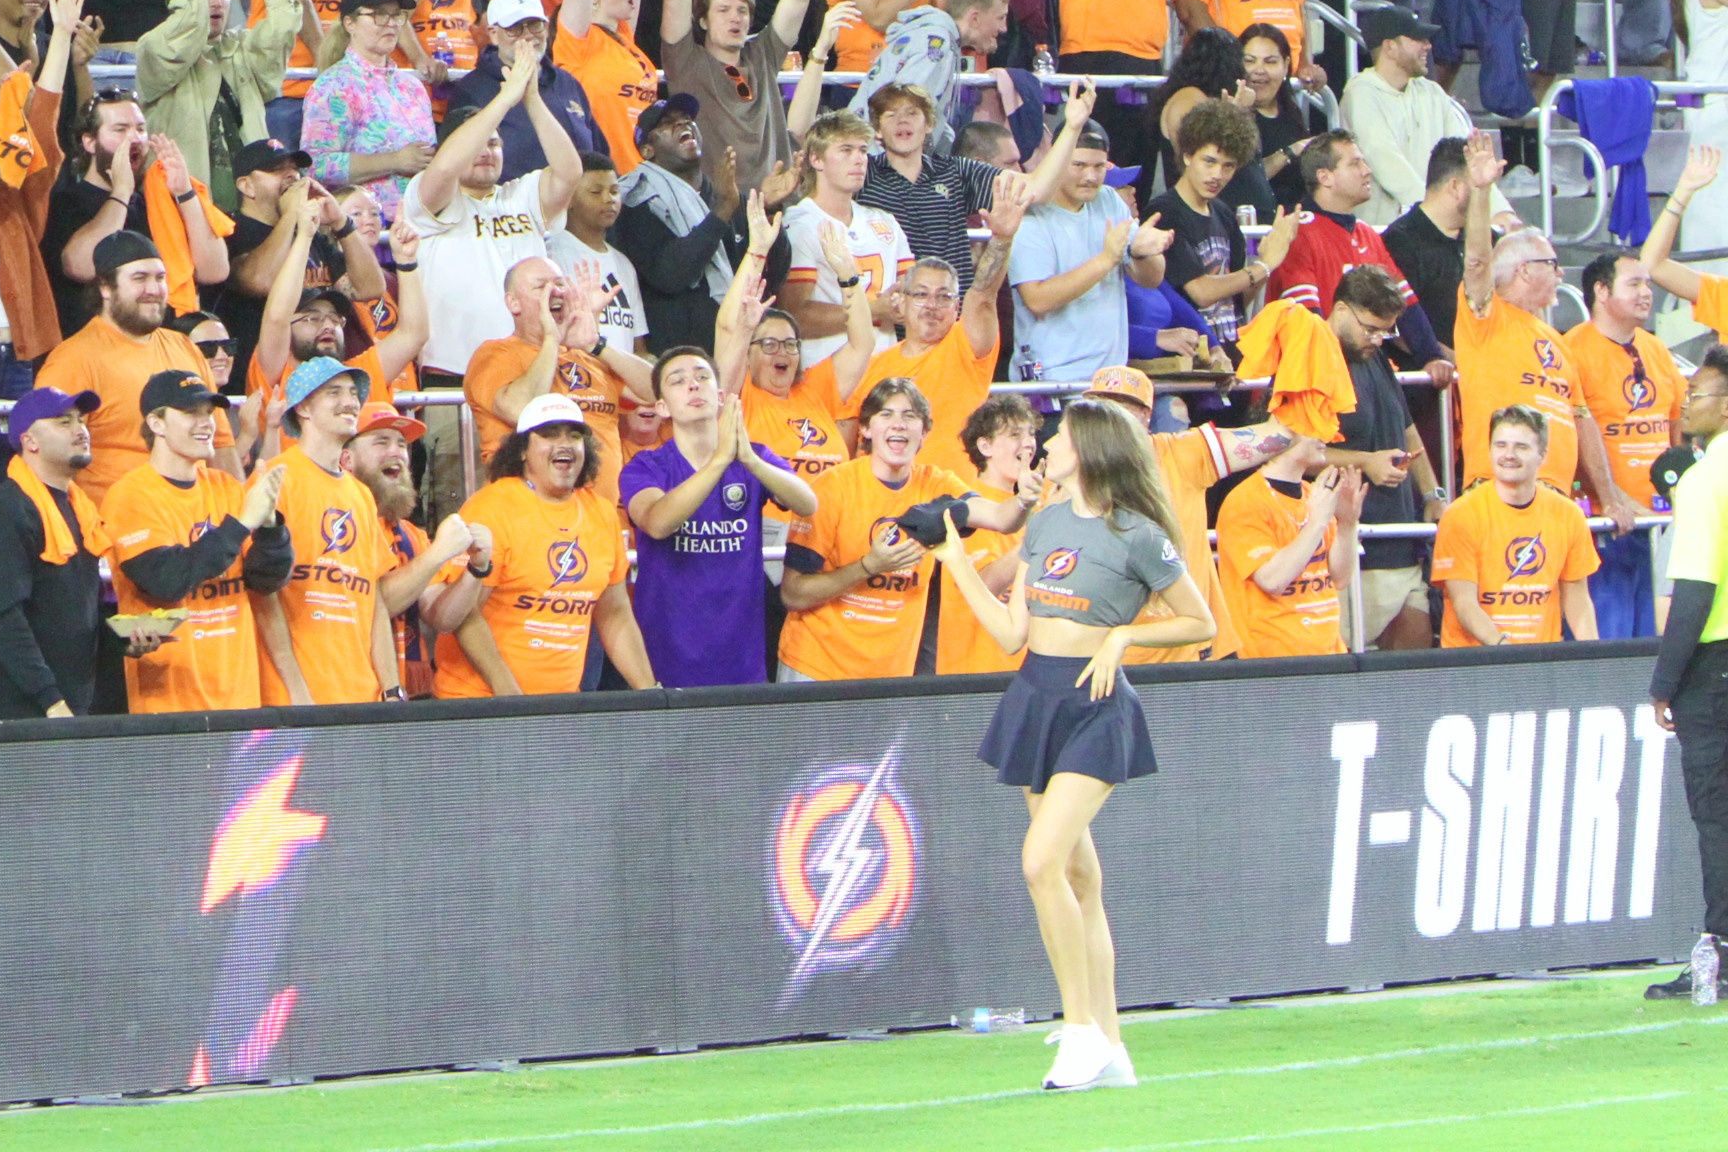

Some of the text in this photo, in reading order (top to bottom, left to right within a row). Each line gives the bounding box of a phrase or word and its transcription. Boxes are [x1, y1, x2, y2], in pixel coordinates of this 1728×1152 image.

[598, 304, 634, 330] didas
[796, 451, 842, 462] ORLANDO
[674, 519, 748, 539] RLANDO
[292, 566, 371, 596] STORM
[1033, 581, 1074, 596] ORLANDO
[543, 591, 594, 601] ORLANDO
[1325, 703, 1675, 946] T-SHIRT
